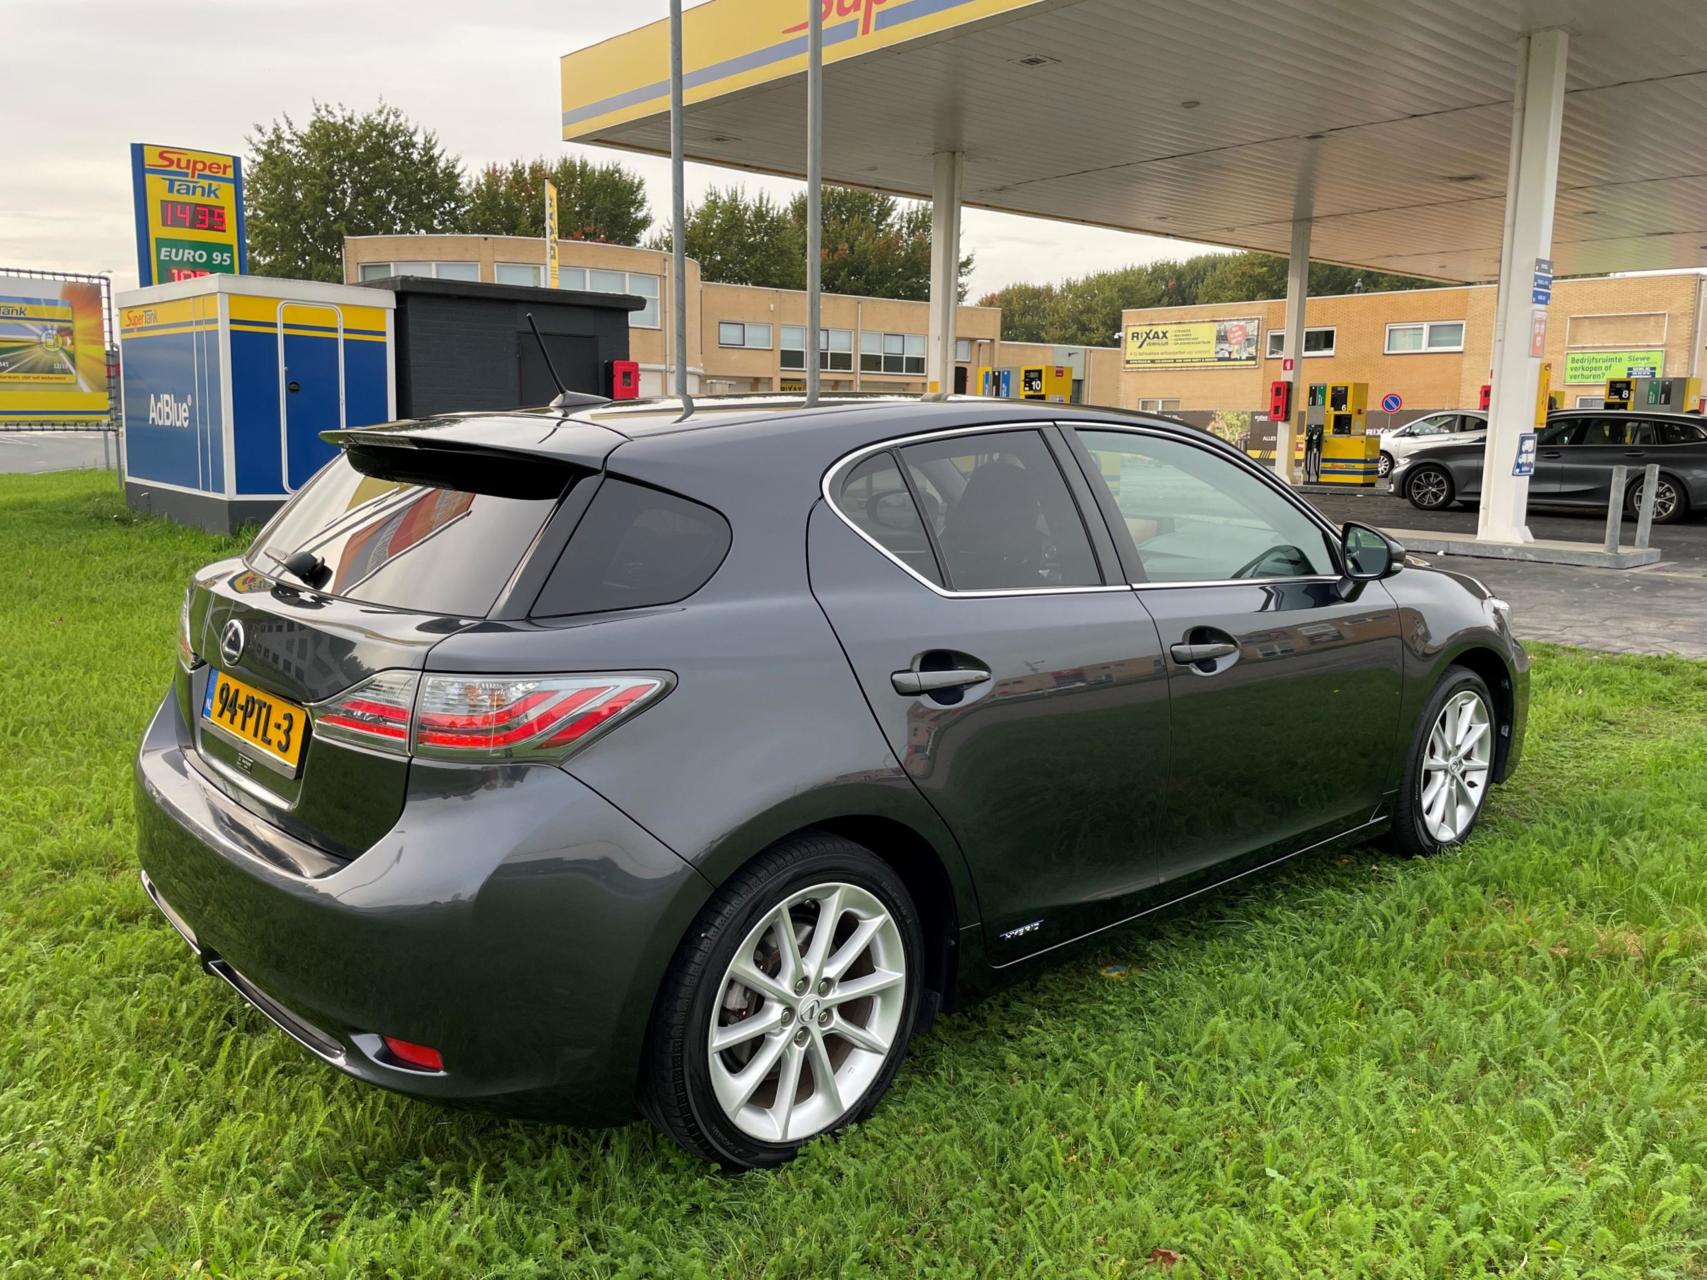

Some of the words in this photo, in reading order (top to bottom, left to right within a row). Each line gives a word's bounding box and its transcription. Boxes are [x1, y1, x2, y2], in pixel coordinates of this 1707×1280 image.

[145, 150, 232, 179] Super
[161, 177, 220, 199] Tank
[160, 247, 207, 263] EURO
[212, 252, 231, 265] 95
[1570, 356, 1622, 365] Bedrijfsruimte
[1570, 364, 1602, 372] verkopen
[1569, 372, 1606, 380] verhuren?
[1031, 380, 1041, 390] 10
[1622, 390, 1629, 398] 8
[217, 682, 294, 754] 94-PTL-3
